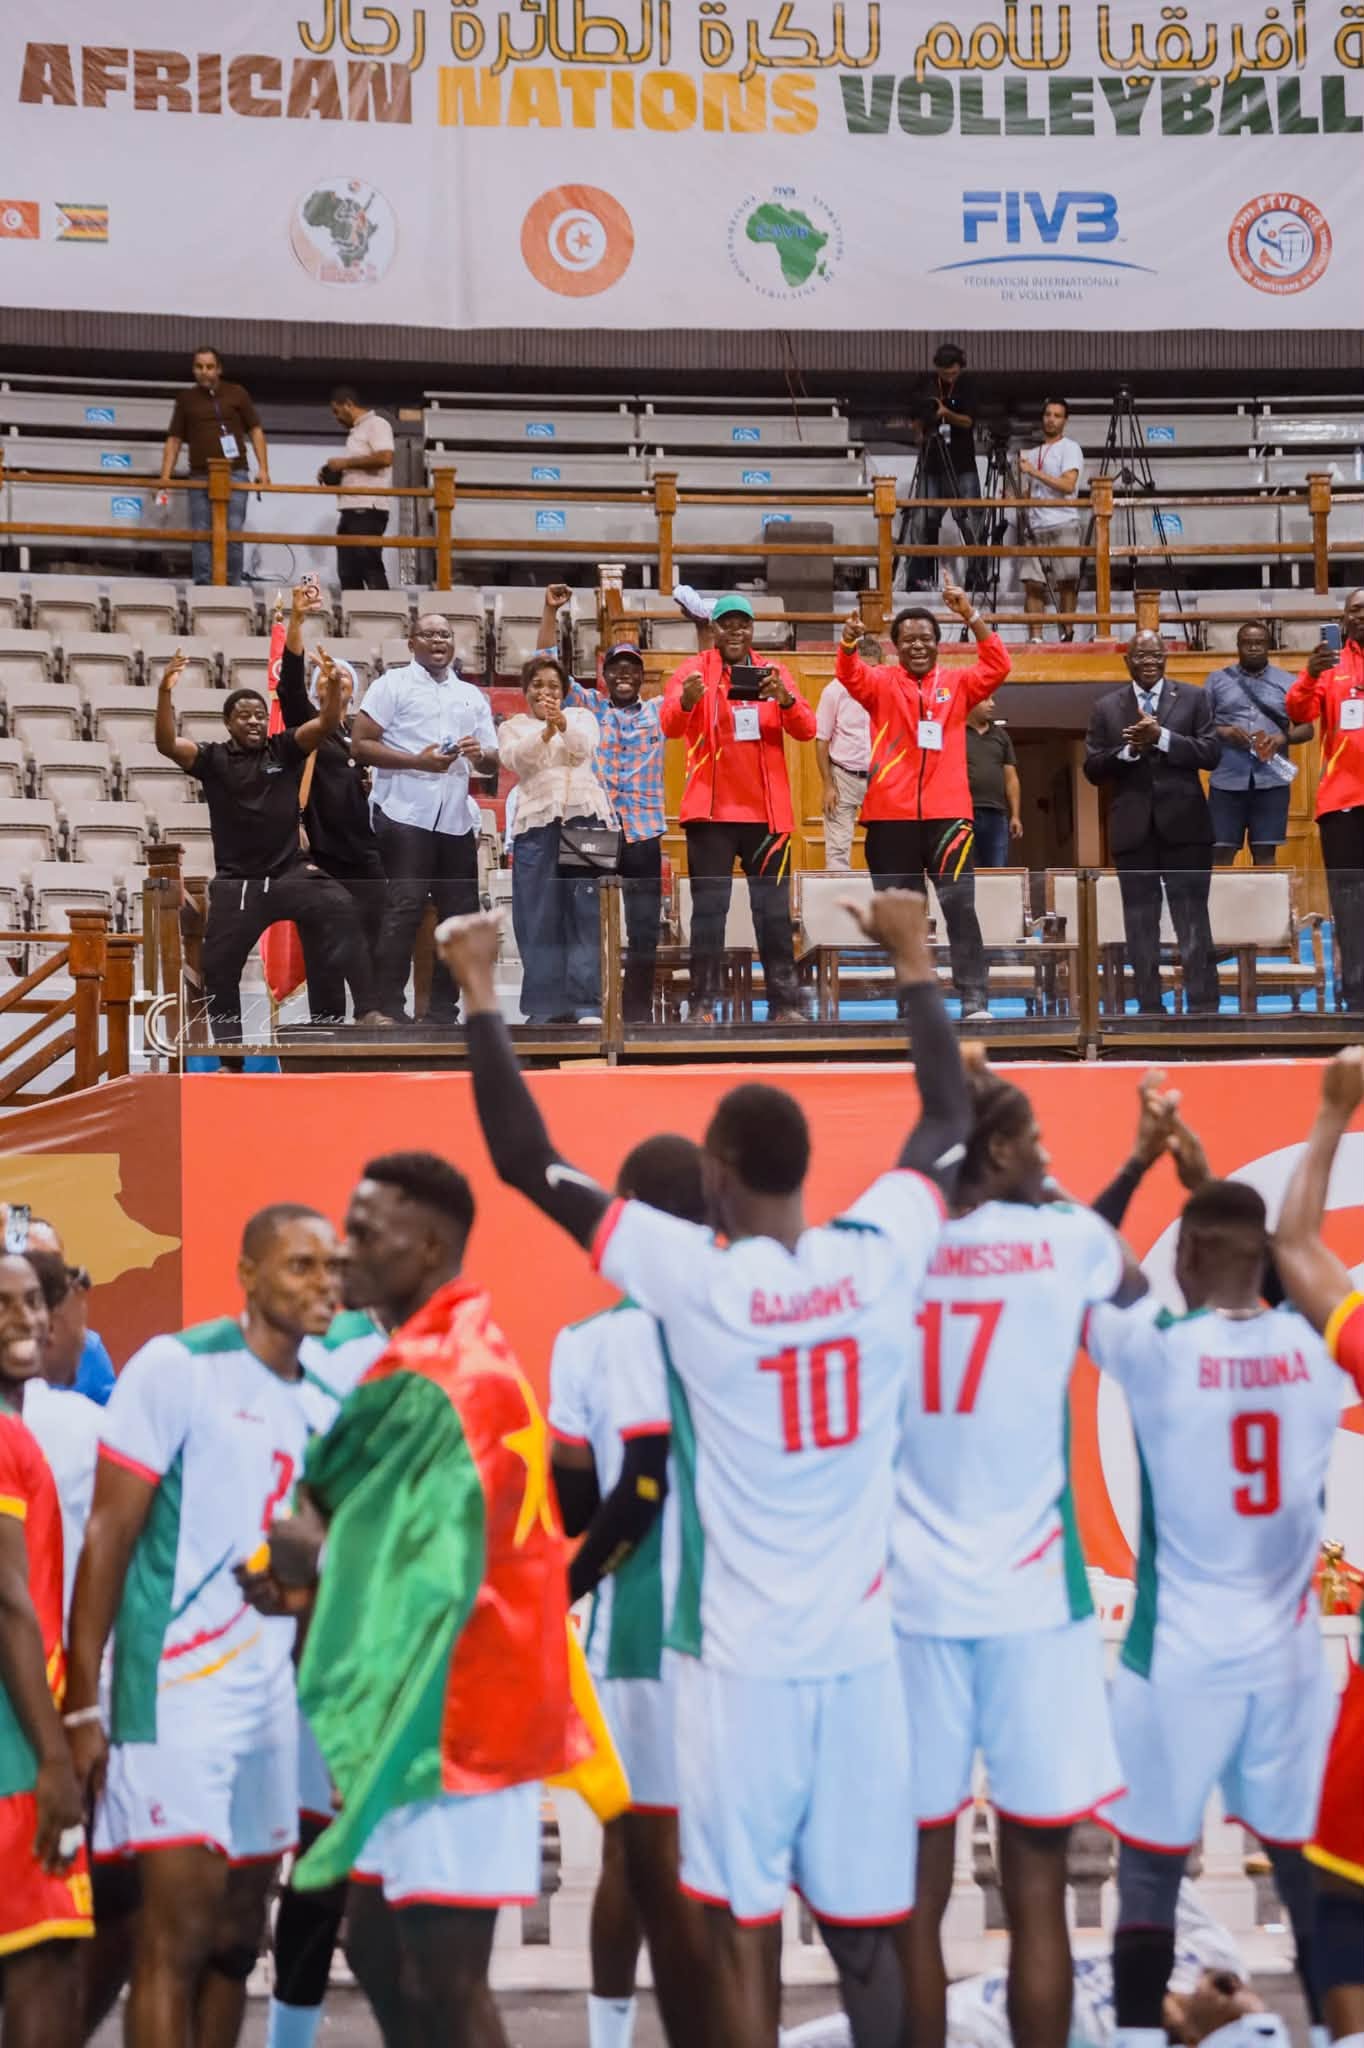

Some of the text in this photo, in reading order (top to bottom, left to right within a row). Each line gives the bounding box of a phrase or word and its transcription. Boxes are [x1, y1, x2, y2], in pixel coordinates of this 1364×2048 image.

[449, 0, 672, 77] الطائرة
[699, 1, 880, 83] للكرة
[18, 41, 1364, 137] AFRICAN NATIONS VOLLEYBALL
[962, 191, 1120, 244] FIVB
[1018, 289, 1084, 301] VOLLEYBALL
[1032, 275, 1120, 287] INTERNATIONALE
[755, 1335, 861, 1453] 10
[914, 1299, 1005, 1415] 17
[1197, 1349, 1310, 1389] BITOUNA
[1231, 1410, 1281, 1518] 9
